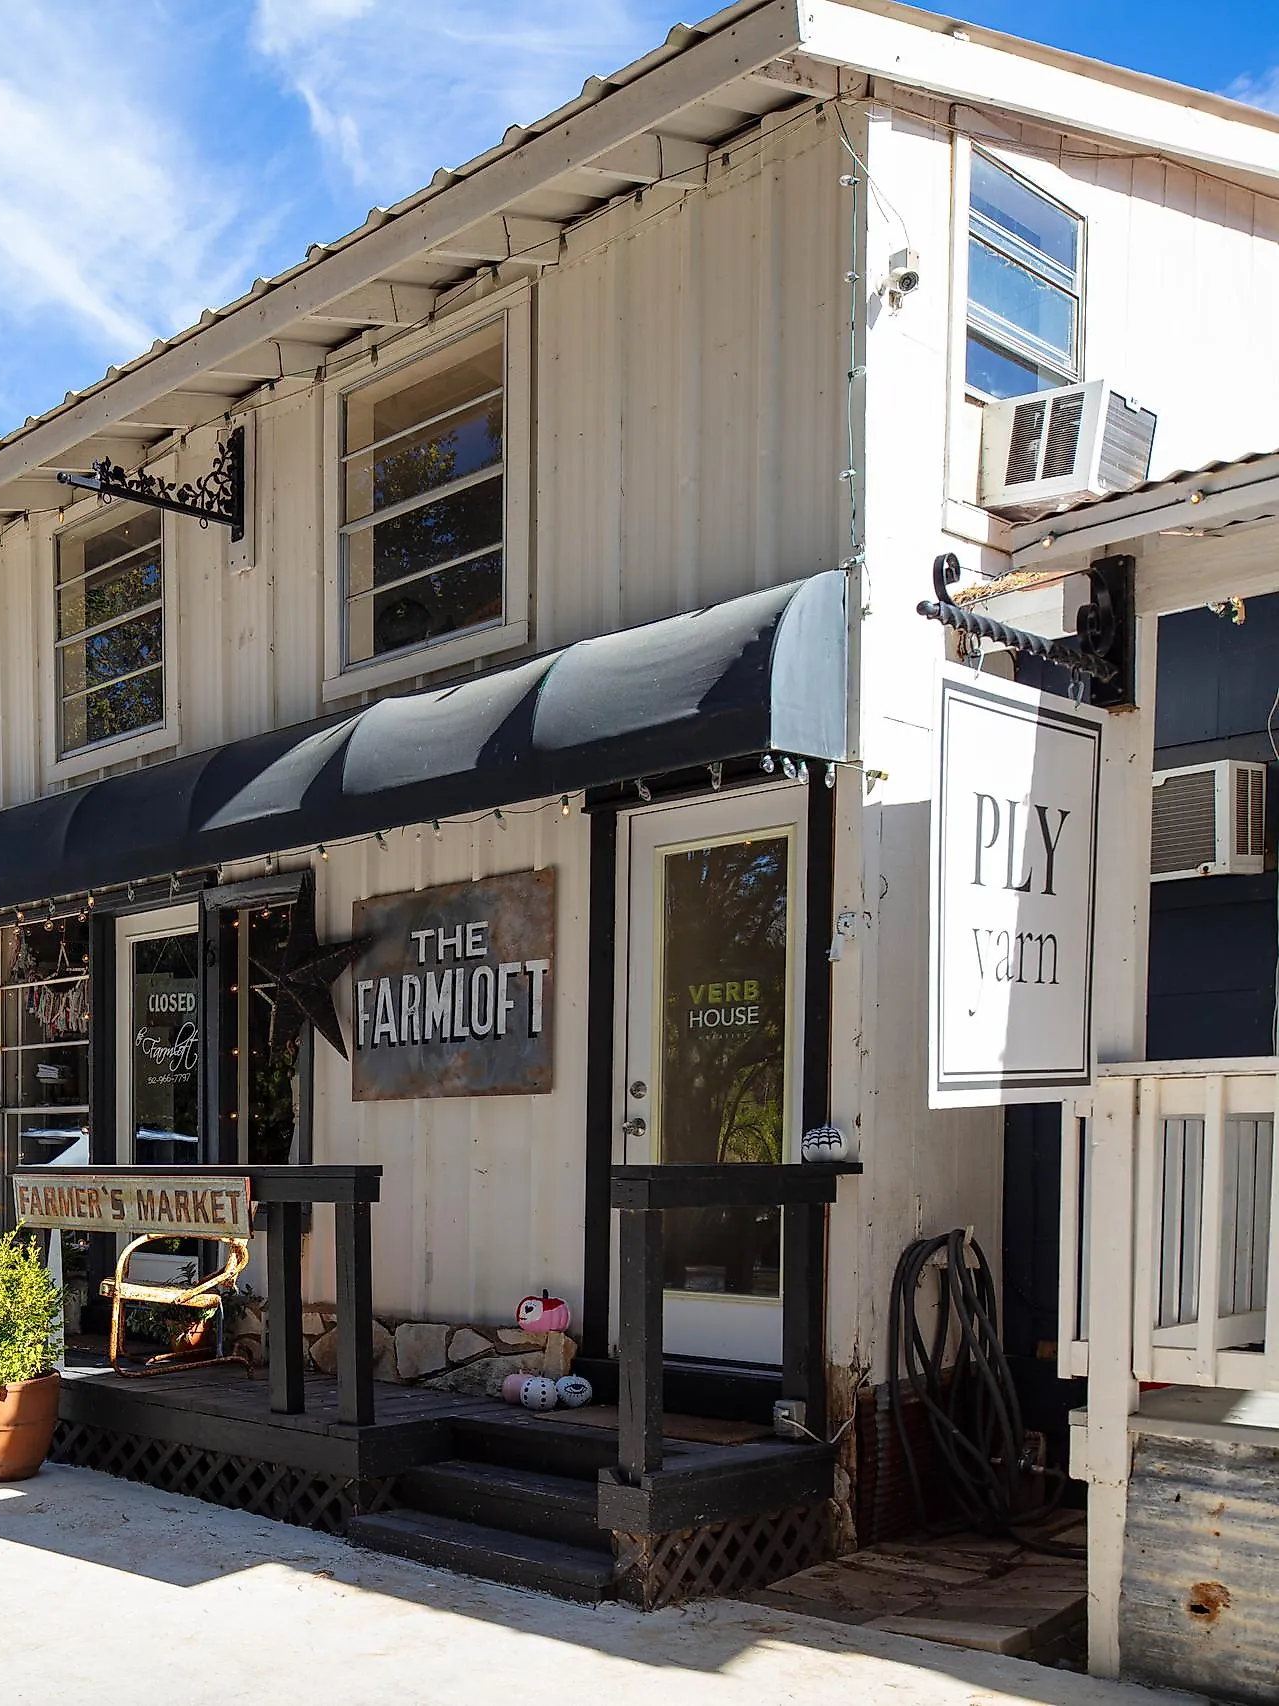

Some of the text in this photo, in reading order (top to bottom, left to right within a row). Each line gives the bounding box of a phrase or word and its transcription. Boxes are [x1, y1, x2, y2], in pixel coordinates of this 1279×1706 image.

[970, 791, 1072, 896] PLY
[410, 920, 489, 965] THE
[688, 980, 760, 1005] VERB
[968, 928, 1061, 1017] yarn
[148, 992, 196, 1013] CLOSED
[356, 958, 550, 1049] FARMLOFT
[688, 1006, 760, 1029] HOUSE
[18, 1185, 241, 1225] FARMER'S MARKET
